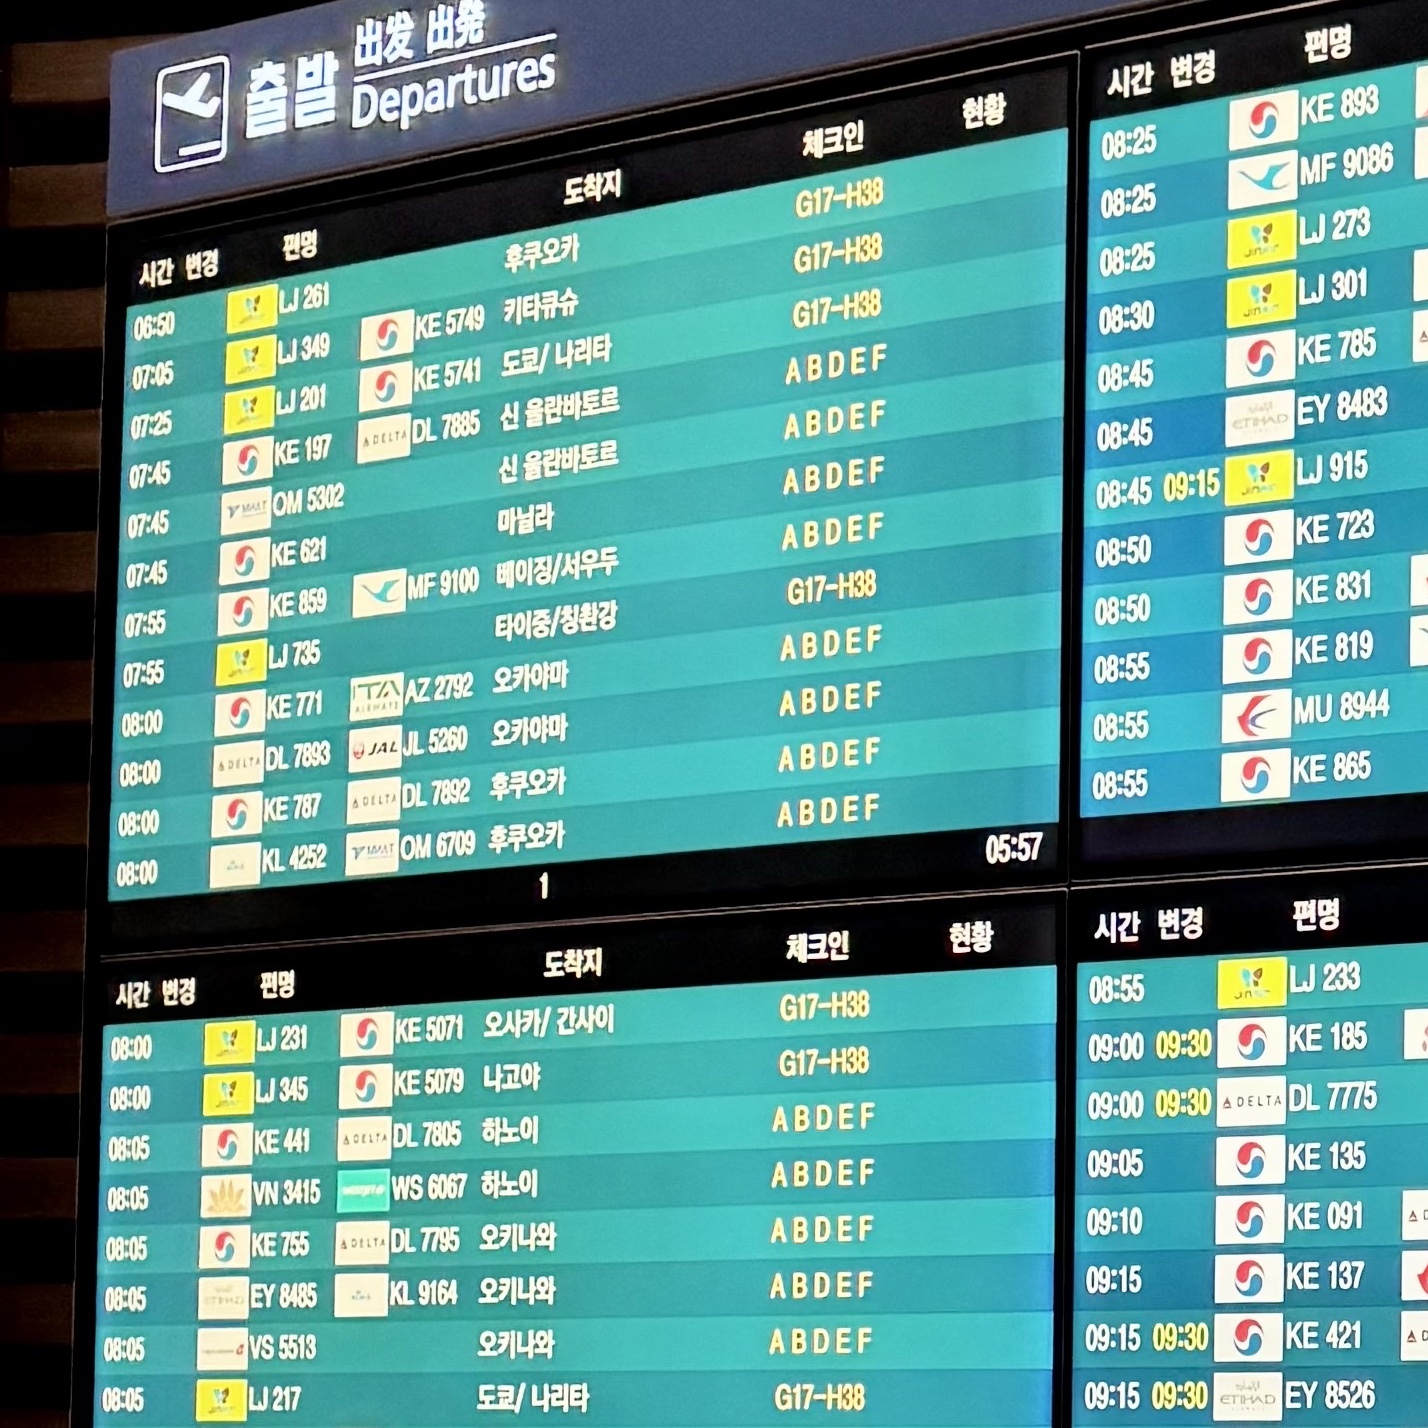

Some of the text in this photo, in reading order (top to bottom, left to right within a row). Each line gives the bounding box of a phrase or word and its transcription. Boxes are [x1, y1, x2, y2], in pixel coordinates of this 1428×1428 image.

[355, 11, 415, 67] 出发
[246, 51, 339, 138] 출발
[351, 53, 556, 130] Departures
[1107, 61, 1155, 98] 시간
[1301, 84, 1379, 125] KE 893
[803, 119, 864, 158] 체크인
[1102, 124, 1157, 160] 08:25
[564, 168, 621, 205] 도착지
[130, 410, 172, 441] 07:25
[1096, 468, 1220, 509] 08:45 09:15
[498, 502, 555, 535] 마닐라
[408, 566, 479, 600] MF 9100
[986, 832, 1043, 864] 05:57
[1089, 1028, 1212, 1062] 09:00 09:30
[484, 1062, 541, 1093] 나고야
